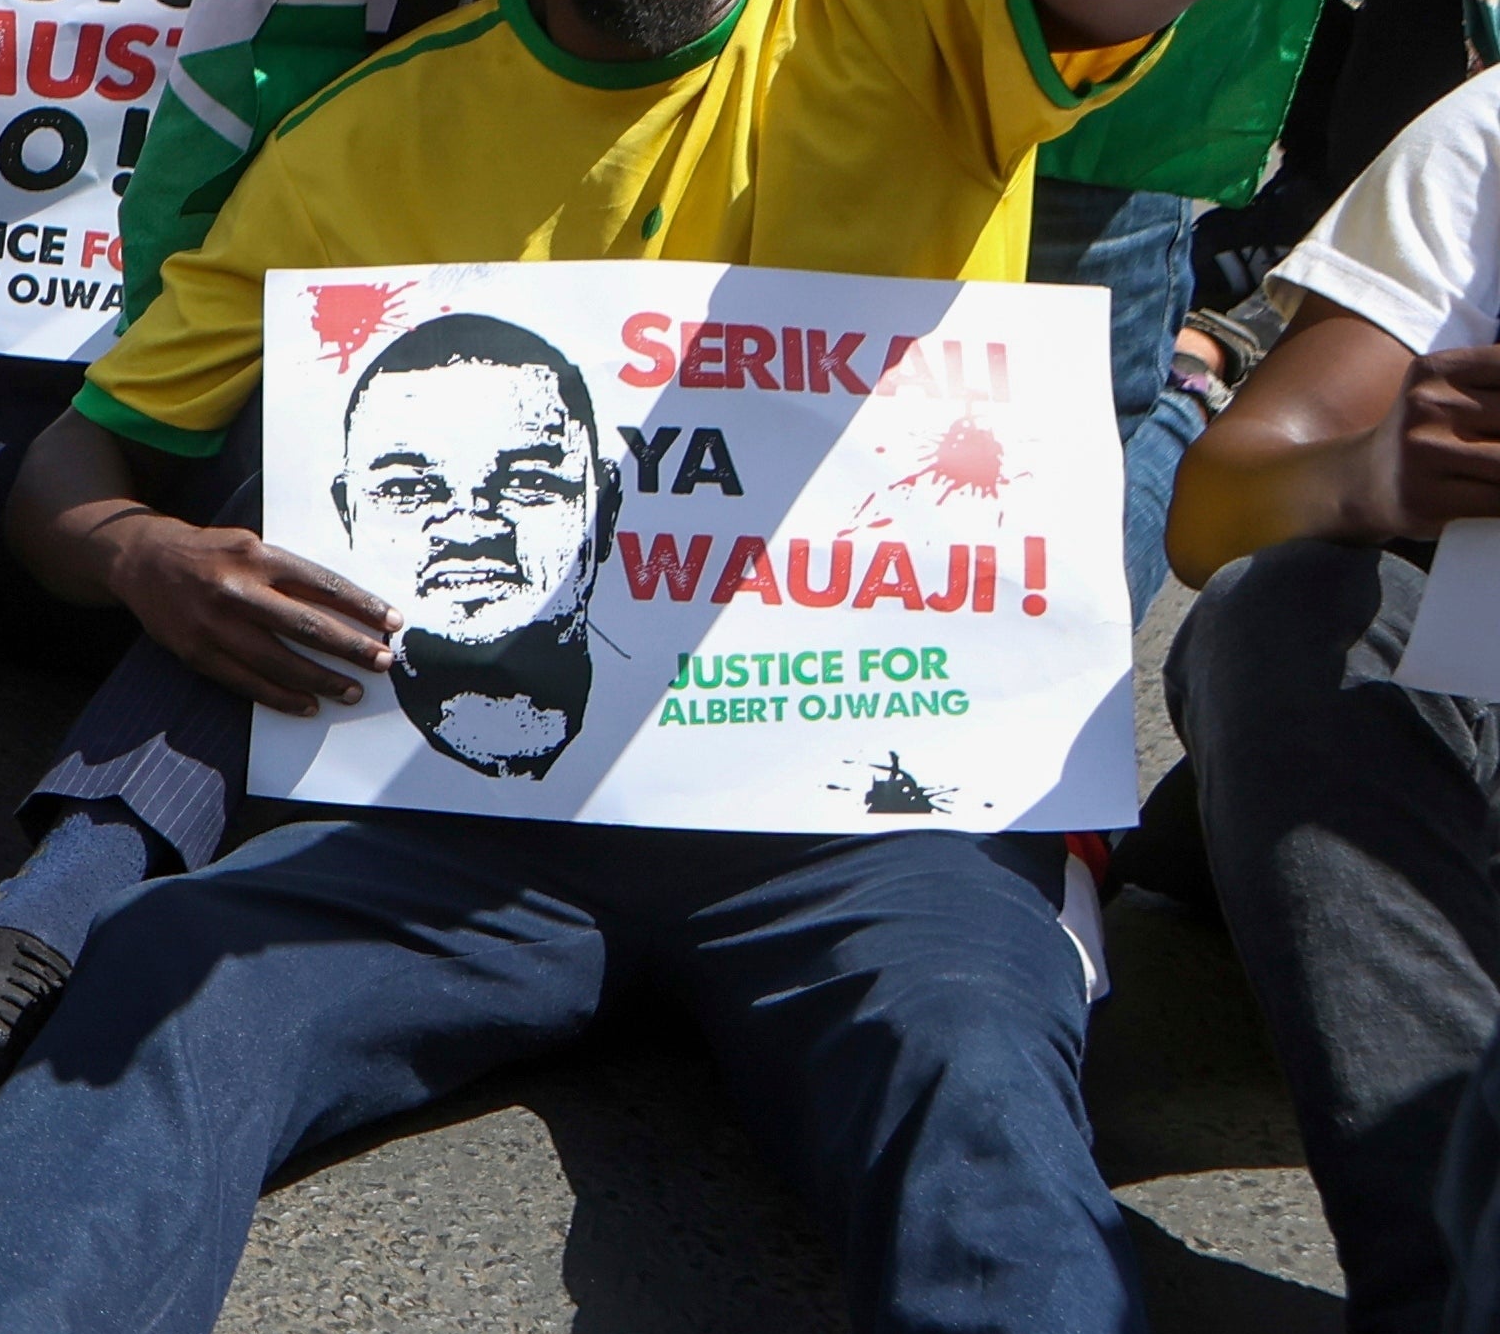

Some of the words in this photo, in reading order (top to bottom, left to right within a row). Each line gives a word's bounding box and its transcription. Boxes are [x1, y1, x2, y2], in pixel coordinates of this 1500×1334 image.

[7, 272, 125, 313] OJWA
[617, 310, 1010, 405] SERIKALI
[616, 426, 745, 497] YA
[668, 650, 844, 690] JUSTICE
[859, 646, 950, 682] FOR
[658, 696, 789, 727] ALBERT
[798, 689, 970, 722] OJWANG
